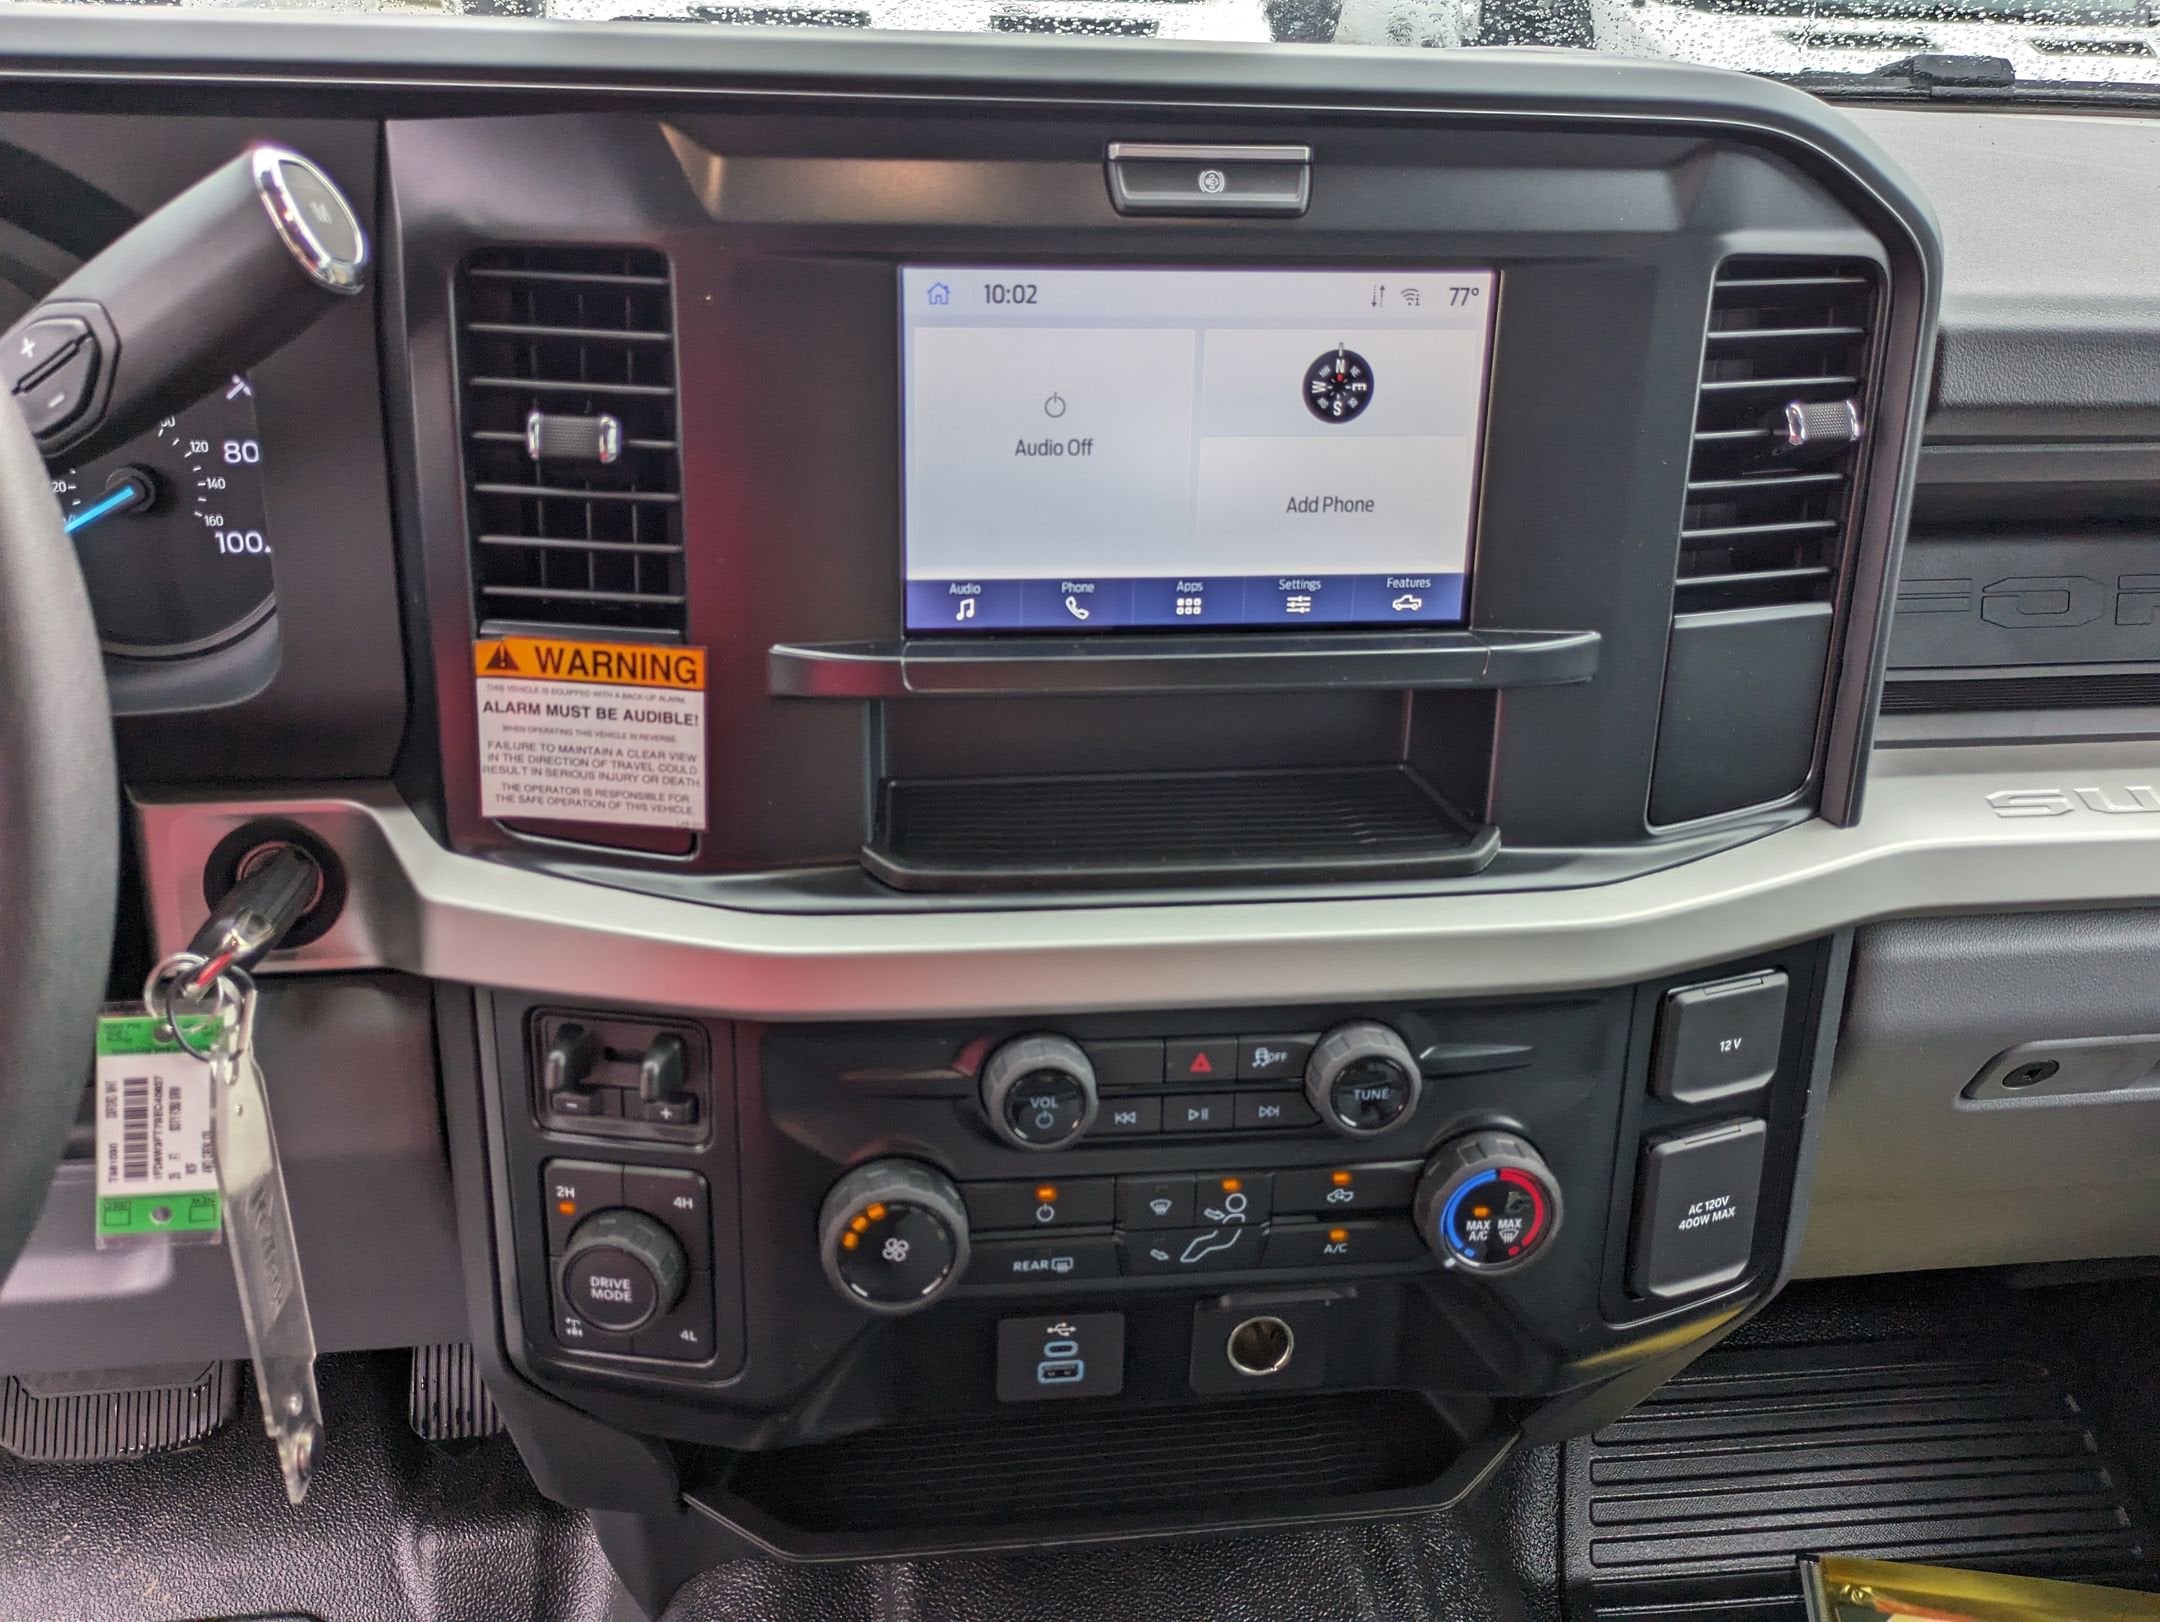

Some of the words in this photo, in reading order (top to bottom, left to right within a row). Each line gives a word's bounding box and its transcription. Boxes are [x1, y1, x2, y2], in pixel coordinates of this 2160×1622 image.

[983, 284, 1038, 305] 10:02
[1449, 287, 1479, 306] 77°
[1335, 358, 1345, 374] N
[1311, 380, 1327, 394] W
[1352, 382, 1367, 391] E
[1333, 400, 1343, 416] S
[190, 441, 209, 454] 120
[224, 440, 260, 464] 80
[1015, 439, 1062, 457] Audio
[1067, 438, 1094, 456] Off
[206, 478, 226, 490] 140
[1286, 496, 1320, 513] Add
[1322, 495, 1375, 514] Phone
[205, 515, 224, 527] 160
[214, 531, 264, 554] 100
[949, 582, 981, 596] Audio
[1061, 581, 1095, 594] Phone
[1176, 580, 1203, 595] Apps
[1279, 578, 1322, 593] Settings
[1386, 576, 1431, 590] Features
[534, 645, 697, 684] WARNING
[507, 685, 539, 695] VEHICLE
[551, 687, 591, 698] EQUIPPED
[483, 700, 541, 716] ALARM
[546, 703, 592, 719] MUST
[596, 706, 618, 721] BE
[623, 708, 699, 727] AUDIBLE!
[502, 725, 526, 733] WHEN
[528, 726, 573, 736] OPERATING
[575, 729, 593, 737] THIS
[595, 730, 627, 740] VEHICLE
[487, 741, 537, 752] FAILURE
[541, 743, 556, 753] TO
[558, 744, 613, 757] MAINTAIN
[616, 749, 624, 758] A
[627, 749, 666, 760] CLEAR
[669, 752, 697, 763] VIEW
[488, 753, 500, 762] IN
[503, 753, 525, 763] THE
[528, 754, 589, 767] DIRECTION
[592, 759, 607, 769] OF
[611, 760, 655, 772] TRAVEL
[658, 763, 698, 775] COULD
[483, 765, 528, 776] RESULT
[531, 767, 543, 776] IN
[545, 768, 595, 780] SERIOUS
[598, 771, 640, 783] INJURY
[642, 774, 659, 784] OR
[502, 782, 521, 792] THE
[524, 783, 580, 796] OPERATOR
[583, 788, 592, 797] IS
[595, 789, 665, 801] RESPONSIBLE
[668, 793, 690, 803] FOR
[495, 794, 515, 803] THE
[519, 795, 545, 805] SAFE
[547, 796, 606, 809] OPERATION
[608, 801, 622, 810] OF
[625, 801, 648, 812] THIS
[1269, 1051, 1288, 1063] OFF
[1353, 1088, 1389, 1101] TUNE
[1031, 1096, 1059, 1109] VOL
[556, 1185, 575, 1199] 2H
[673, 1196, 693, 1210] 4H
[1688, 1201, 1703, 1216] AC
[1704, 1195, 1730, 1211] 120V
[1466, 1220, 1491, 1231] MAX
[1497, 1218, 1523, 1229] MAX
[1678, 1213, 1710, 1231] 400W
[1711, 1206, 1737, 1223] MAX
[1468, 1231, 1489, 1241] A/C
[1323, 1243, 1347, 1254] A/C
[1013, 1258, 1049, 1272] REAR
[590, 1275, 631, 1291] DRIVE
[590, 1288, 633, 1302] MODE
[680, 1329, 698, 1343] 4L
